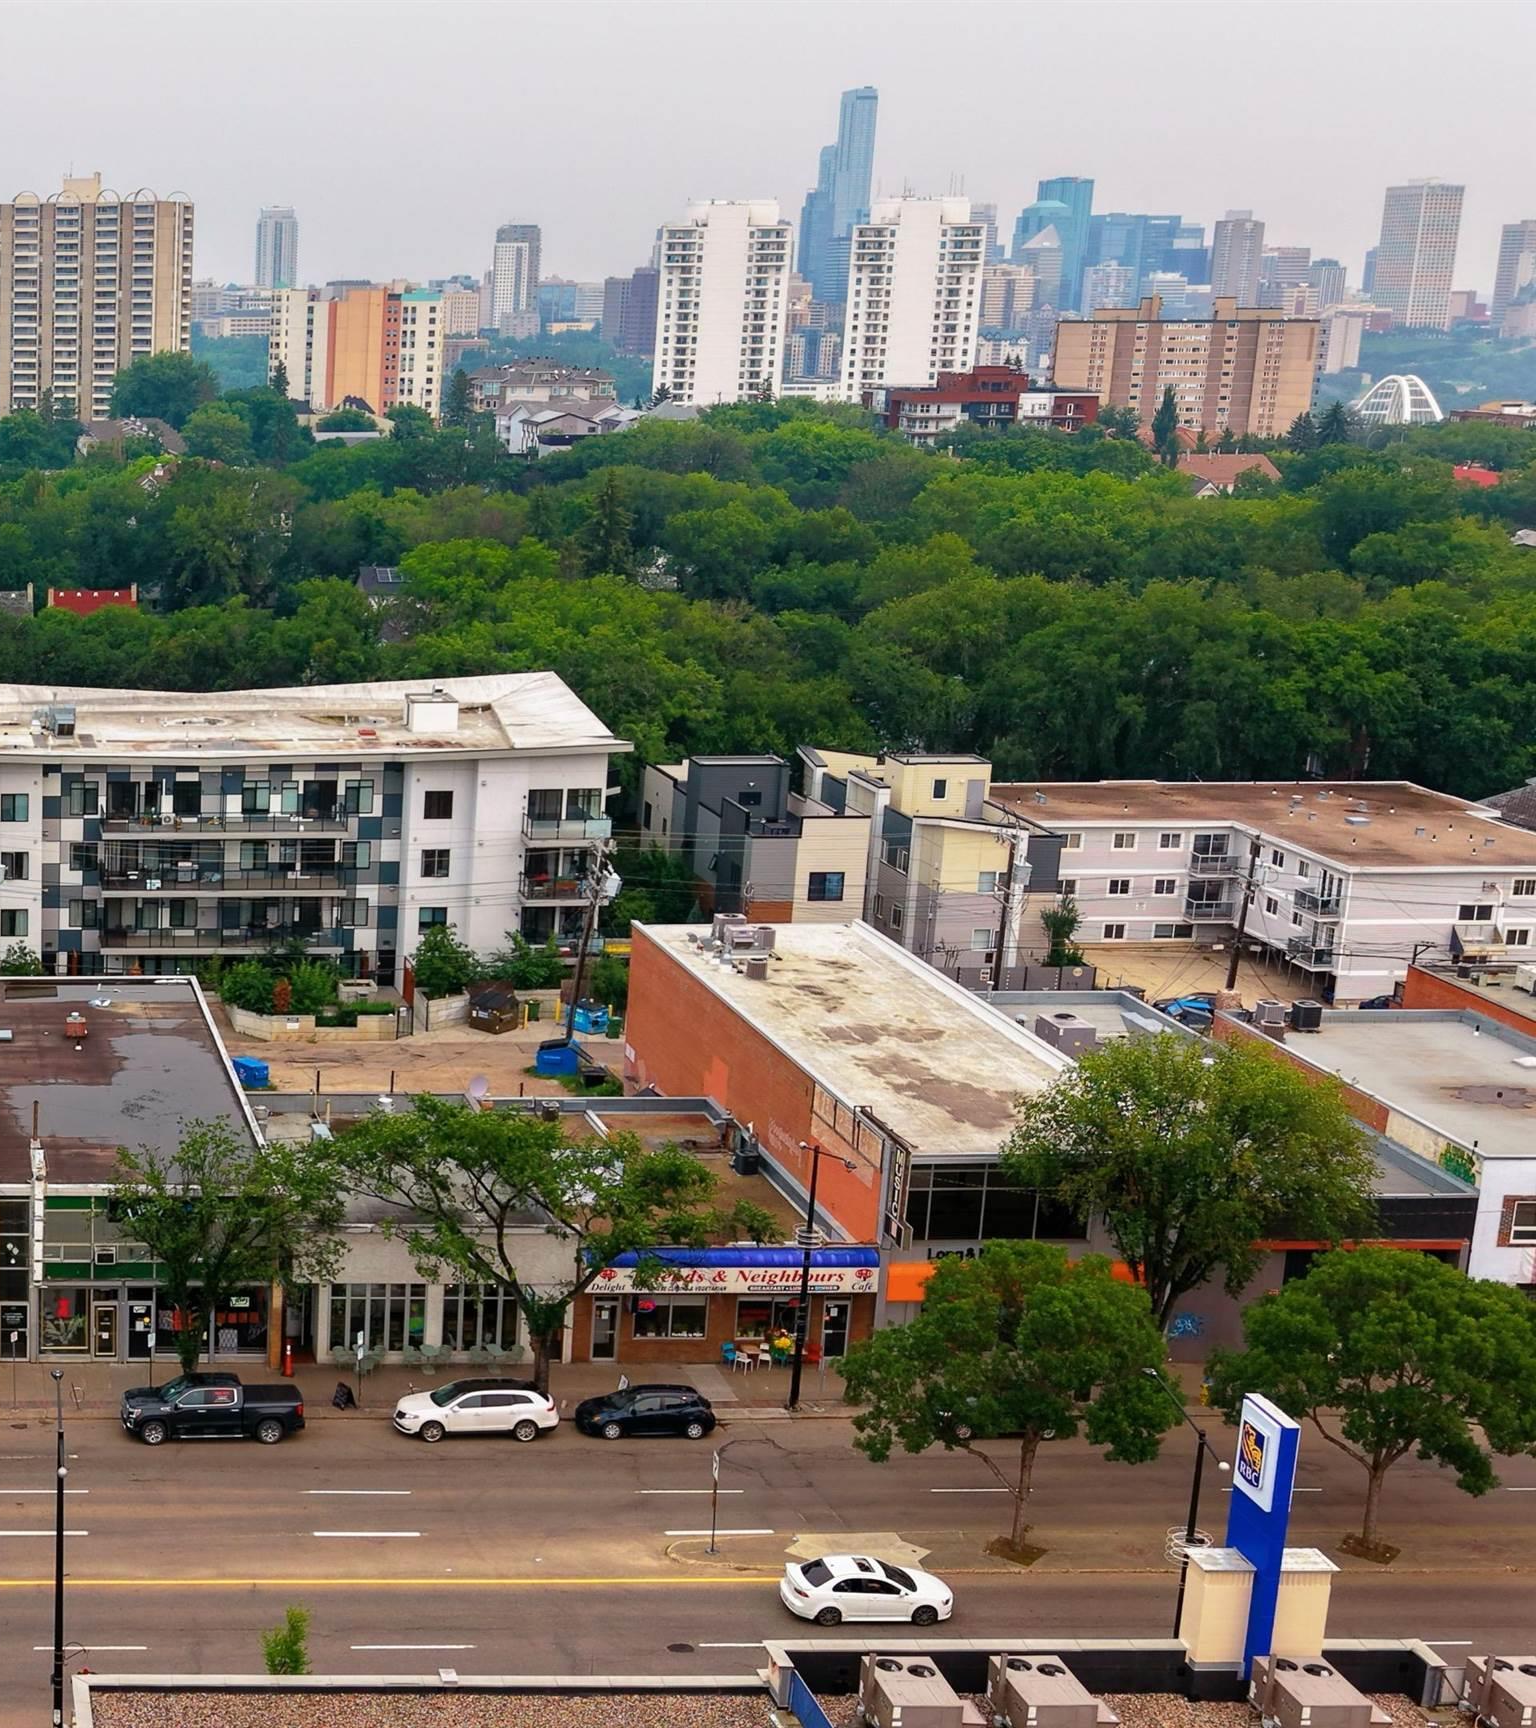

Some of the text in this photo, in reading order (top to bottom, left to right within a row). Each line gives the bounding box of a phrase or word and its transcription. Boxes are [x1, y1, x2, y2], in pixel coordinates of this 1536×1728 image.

[891, 1149, 904, 1217] MUSIC
[712, 1269, 728, 1283] &
[735, 1269, 846, 1285] Neighbours
[591, 1283, 626, 1292] Delight
[851, 1281, 873, 1292] Café
[1238, 1460, 1259, 1486] RBC
